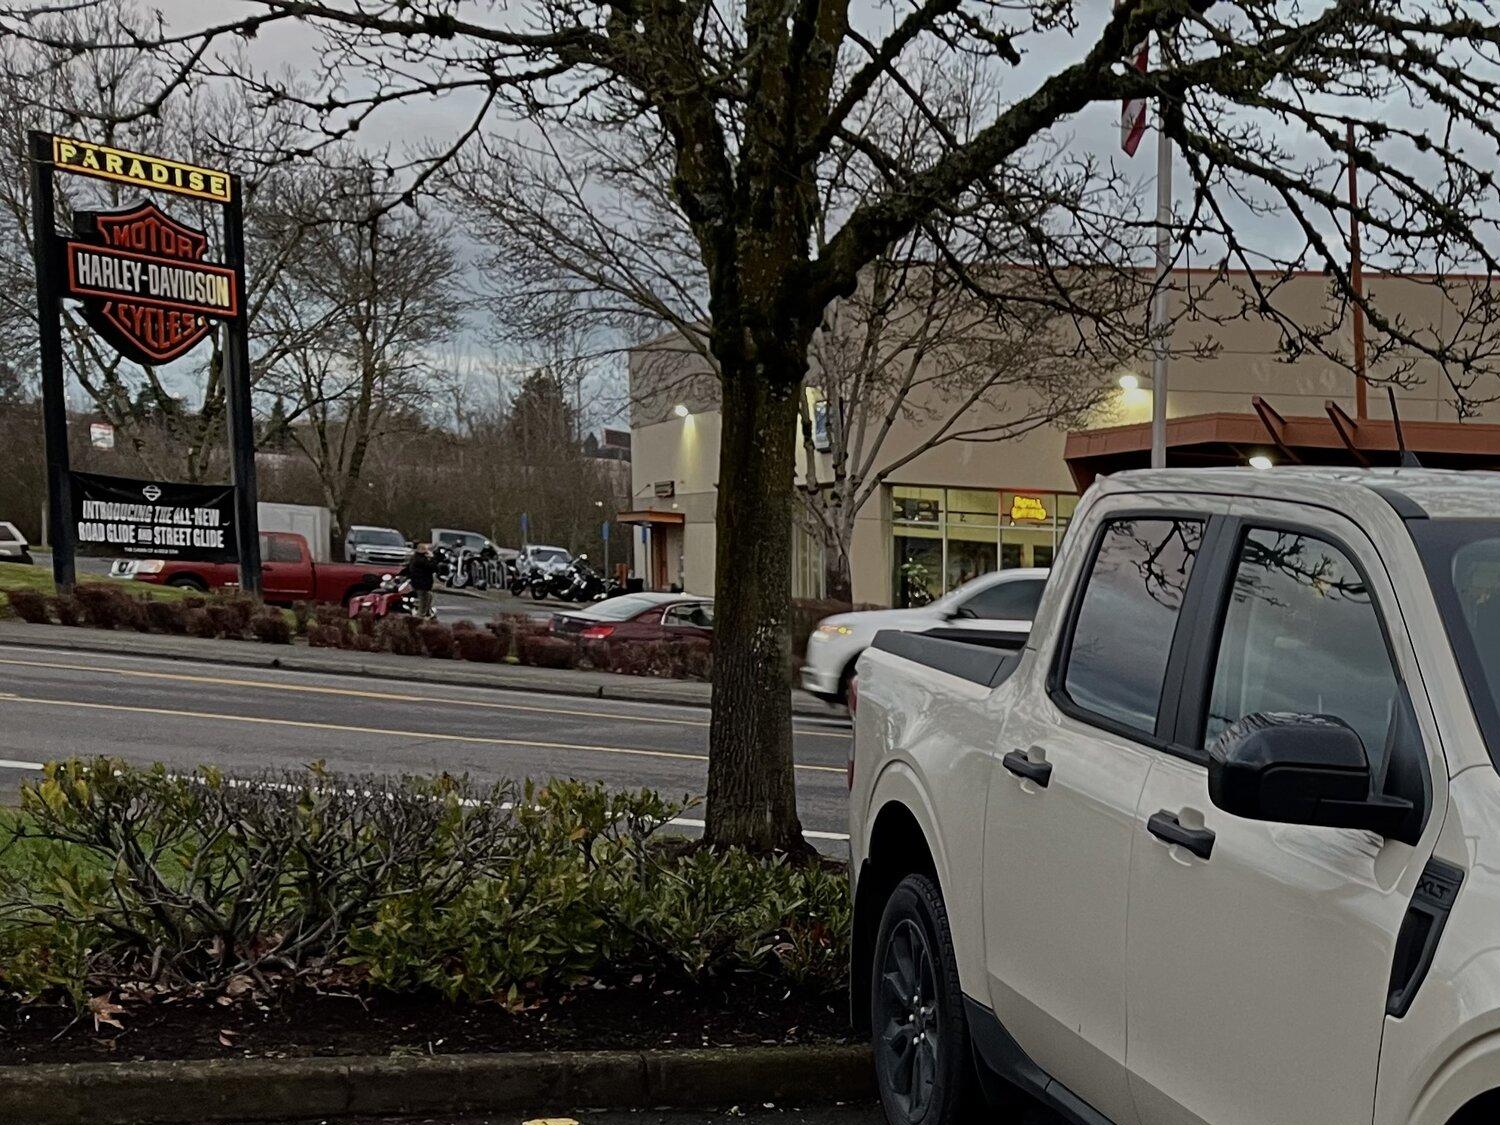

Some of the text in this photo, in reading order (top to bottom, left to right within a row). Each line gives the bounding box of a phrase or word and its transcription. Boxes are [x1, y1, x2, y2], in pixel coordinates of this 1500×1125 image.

[60, 143, 226, 196] PARADISE
[113, 217, 194, 259] MOTOR
[77, 252, 230, 307] HARLEY-DAVIDSON
[118, 303, 196, 349] CYCLES
[78, 521, 106, 542] ROAD
[106, 524, 136, 544] GLIDE
[154, 526, 192, 547] STREET
[193, 529, 224, 549] GLIDE
[82, 500, 220, 527] INTRODUCING THE ALL-NEW
